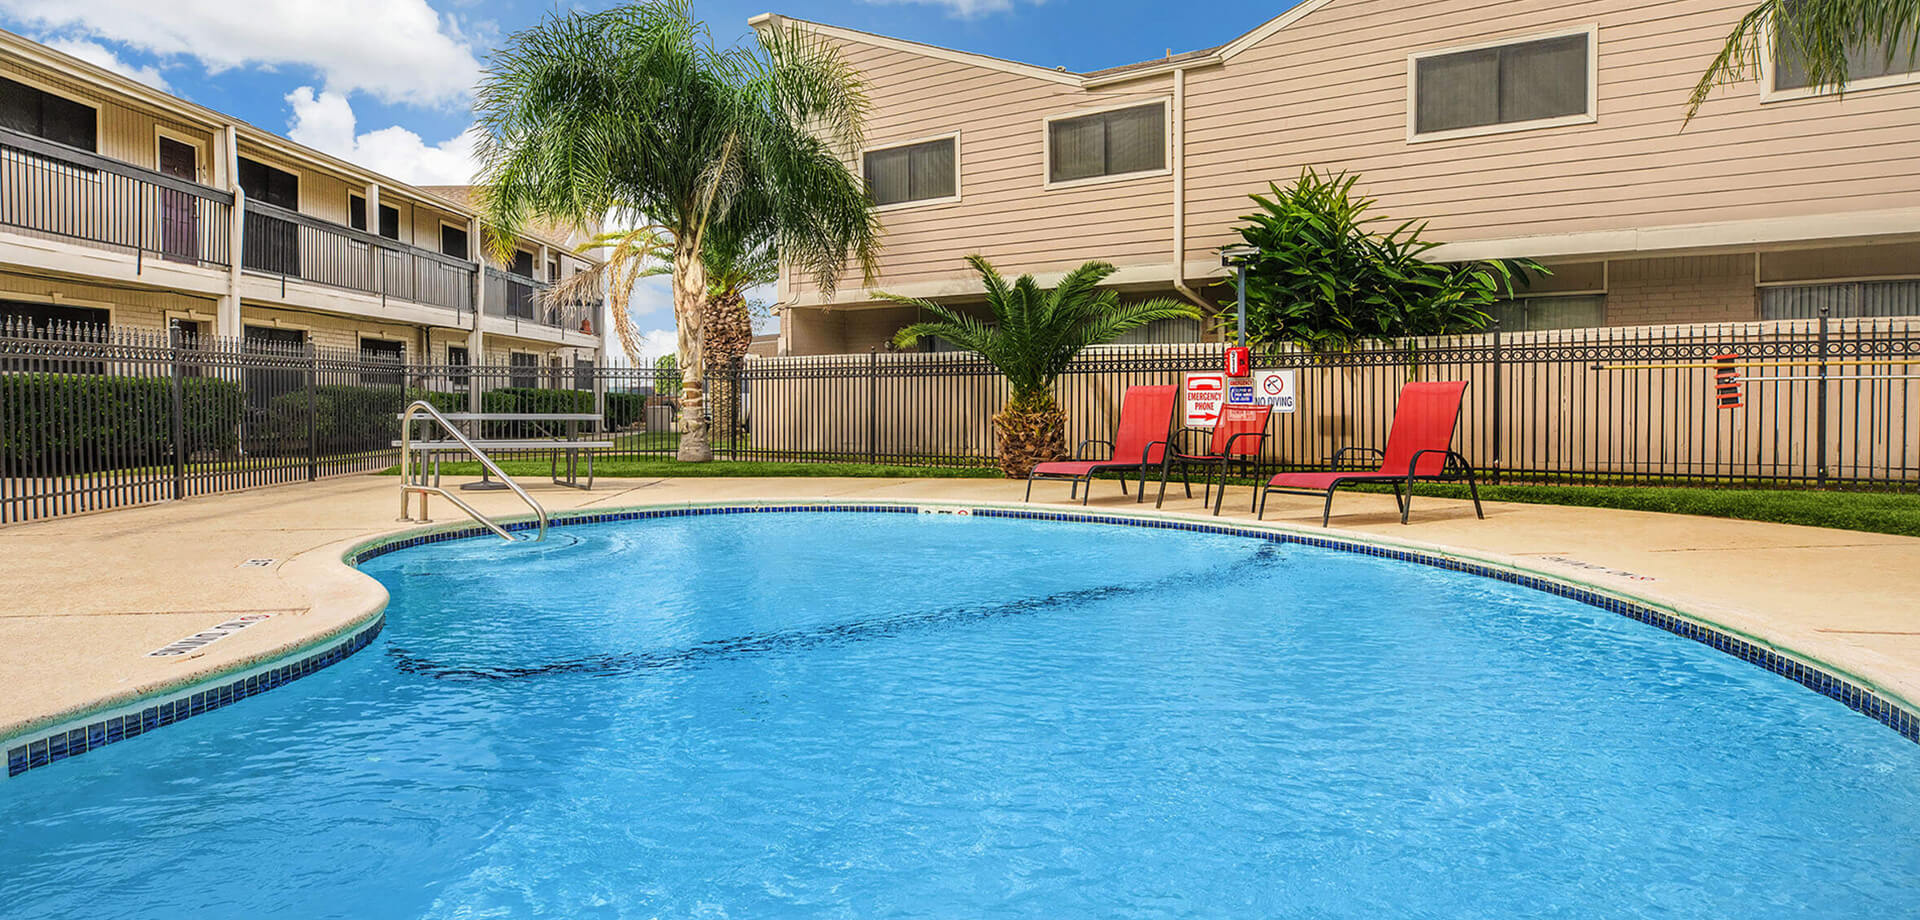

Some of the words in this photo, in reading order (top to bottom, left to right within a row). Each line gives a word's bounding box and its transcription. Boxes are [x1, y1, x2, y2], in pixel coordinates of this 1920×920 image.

[1188, 392, 1222, 401] EMERGENCY
[1195, 402, 1214, 410] PHONE
[1255, 396, 1266, 406] NO
[1267, 396, 1293, 407] DIVING
